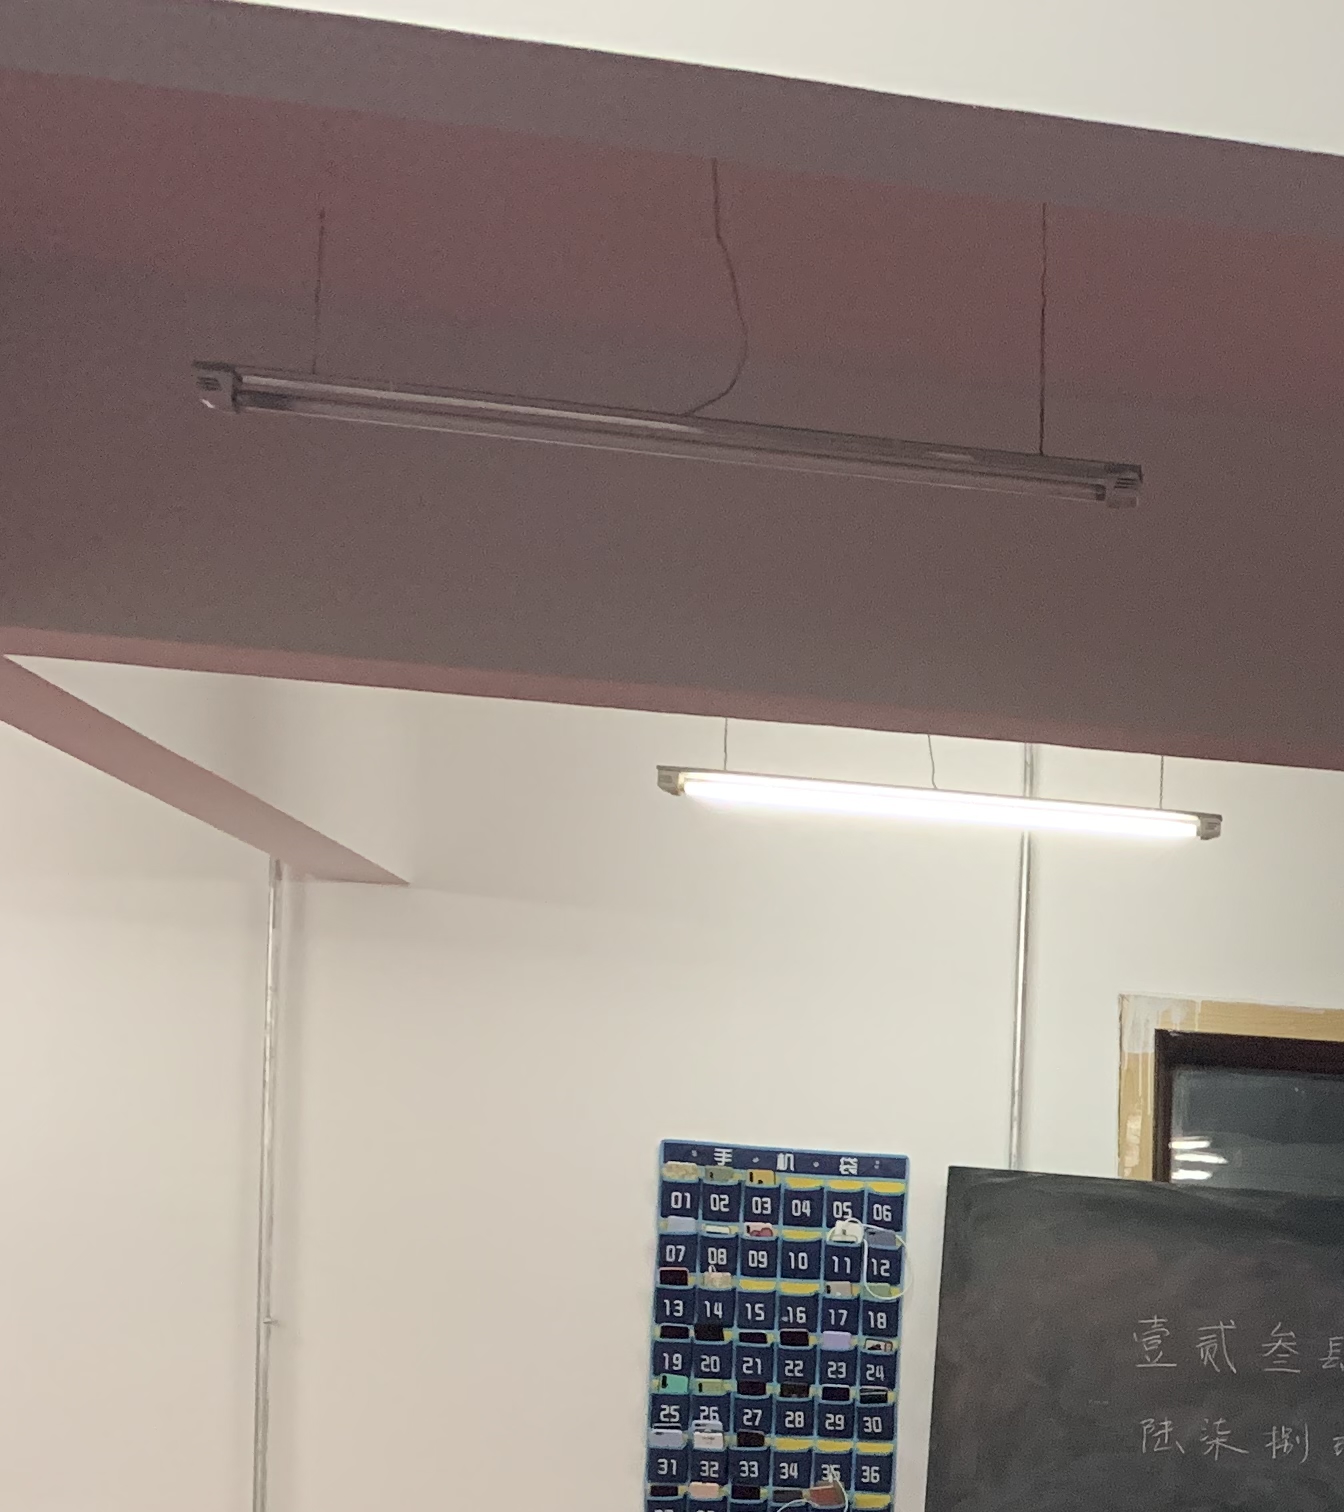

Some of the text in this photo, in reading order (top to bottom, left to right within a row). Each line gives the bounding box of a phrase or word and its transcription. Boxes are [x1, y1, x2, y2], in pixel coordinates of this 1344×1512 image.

[671, 1191, 892, 1221] 01 02 03 04 05 06
[666, 1245, 890, 1276] 07 08 09 10 11 12
[664, 1299, 887, 1329] 13 14 15 16 17 18
[662, 1353, 885, 1382] 19 20 21 22 23 24
[659, 1404, 882, 1433] 25 26 27 28 29 30
[657, 1458, 880, 1483] 31 32 33 34 35 36
